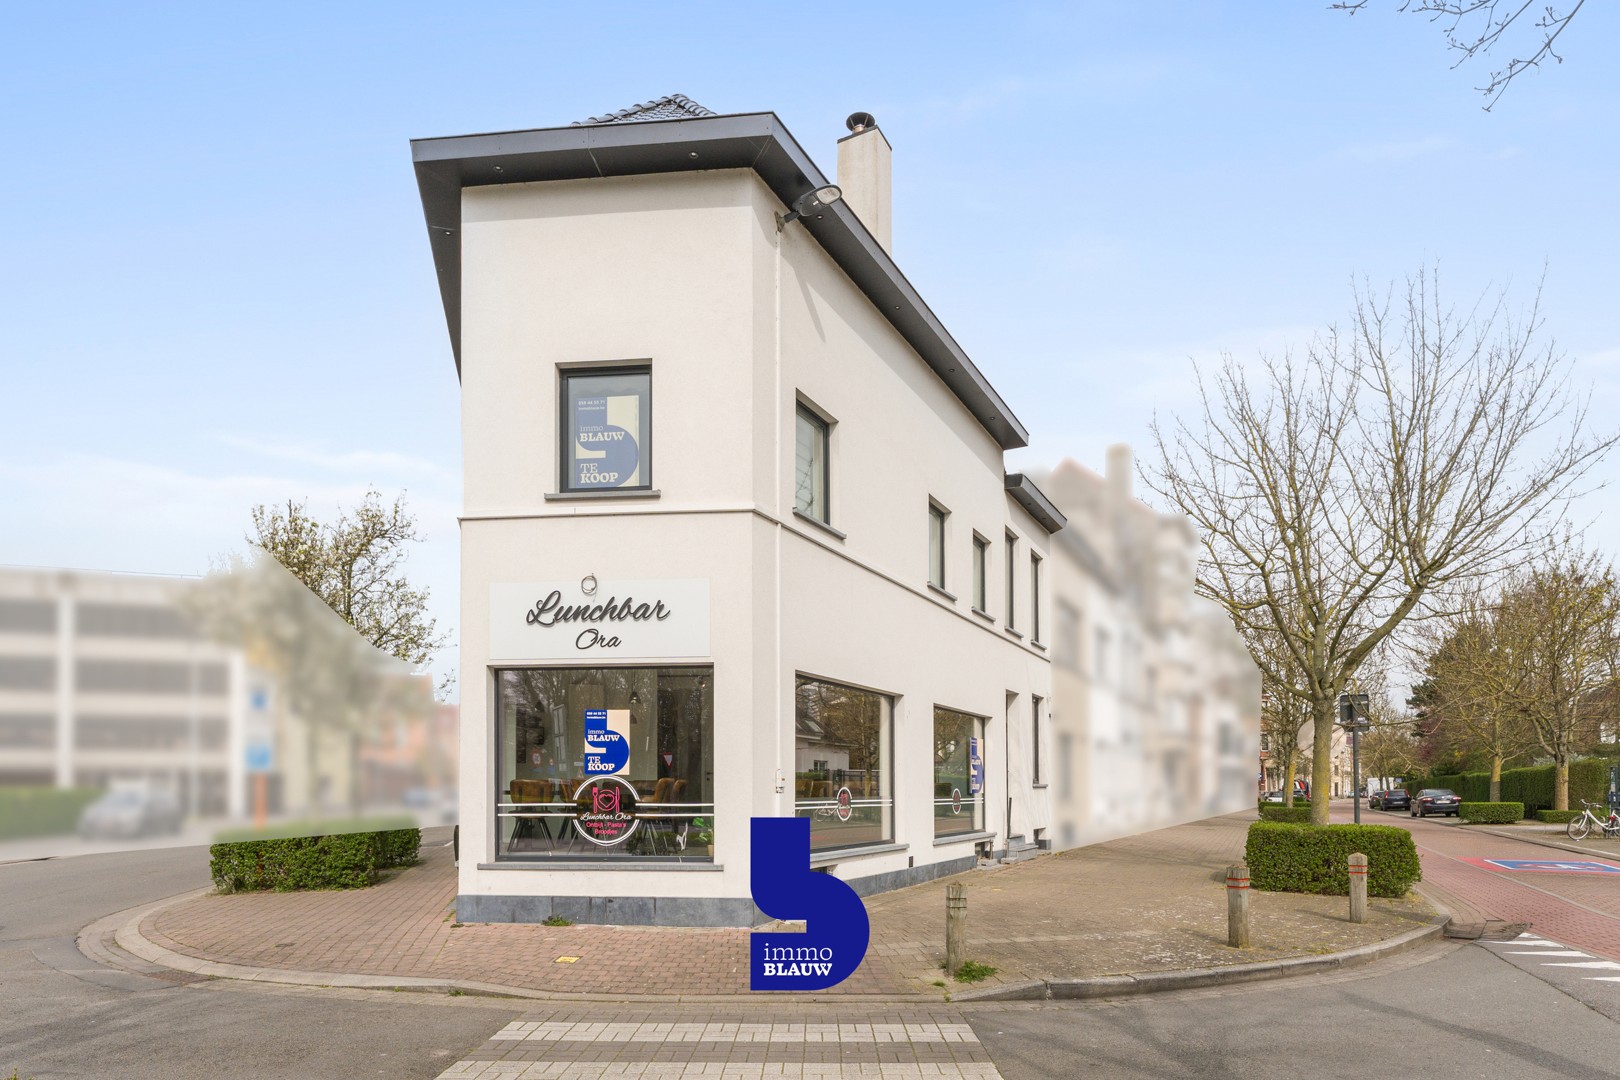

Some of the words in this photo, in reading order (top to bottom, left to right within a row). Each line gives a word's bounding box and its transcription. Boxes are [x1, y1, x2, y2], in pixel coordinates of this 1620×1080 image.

[580, 431, 624, 441] BLAUW
[580, 464, 598, 474] TE
[580, 472, 618, 483] KOOP
[526, 590, 671, 627] Lunchbar
[575, 628, 622, 650] Ora
[580, 812, 614, 821] Lunchbar
[614, 812, 632, 821] Ora
